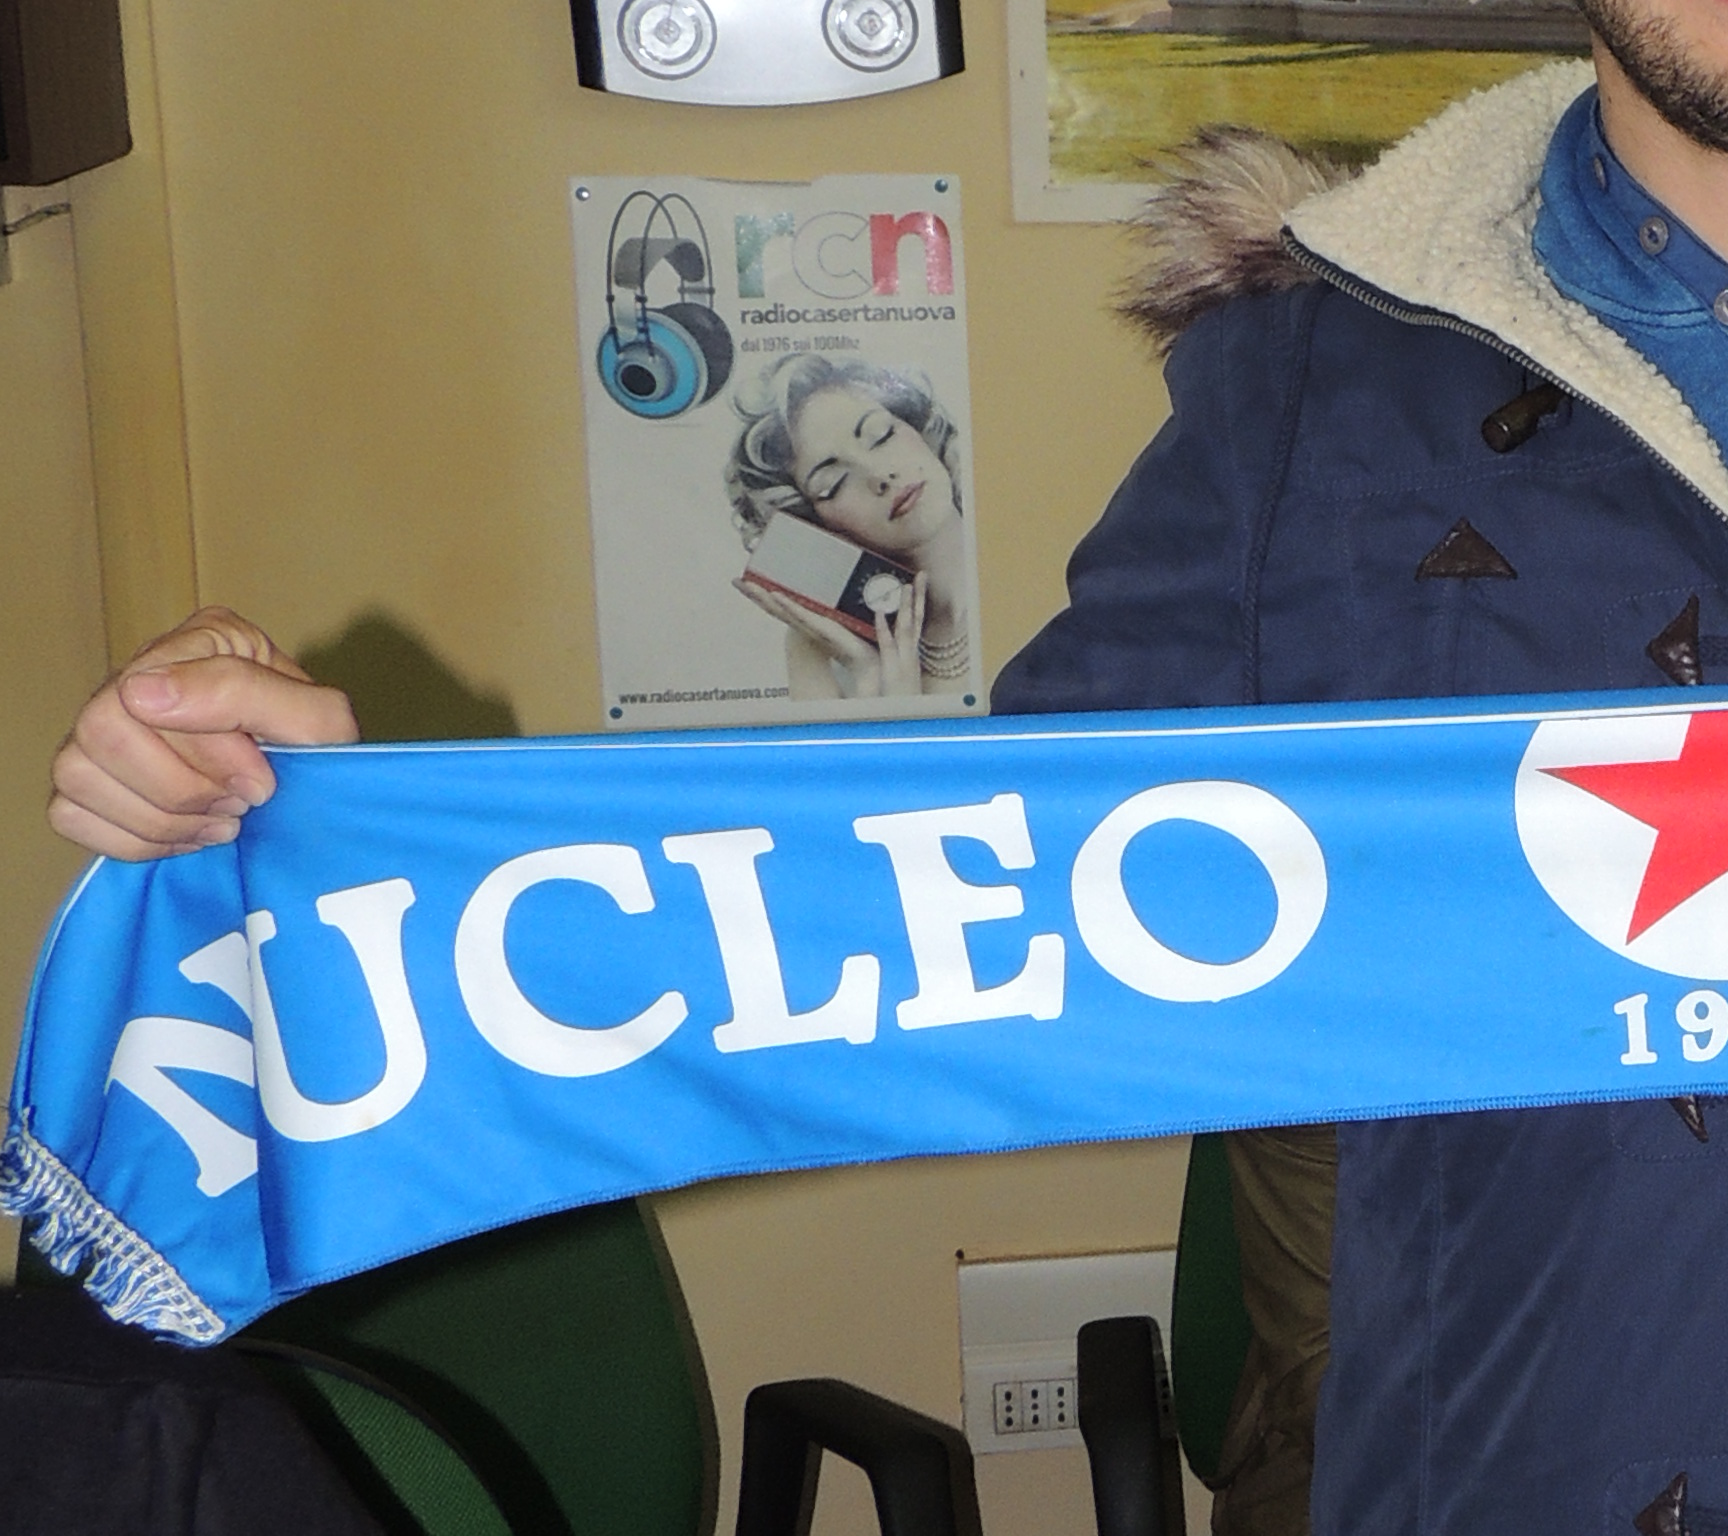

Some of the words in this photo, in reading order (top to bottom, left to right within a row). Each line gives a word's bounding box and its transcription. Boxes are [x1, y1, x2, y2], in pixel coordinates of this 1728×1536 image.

[735, 211, 954, 300] rcn
[740, 302, 956, 325] radiocasertanuova
[740, 337, 760, 352] dal
[763, 336, 790, 352] 1976
[618, 686, 790, 704] www.radiocasertanuova.com
[106, 779, 1327, 1198] NUCLEO
